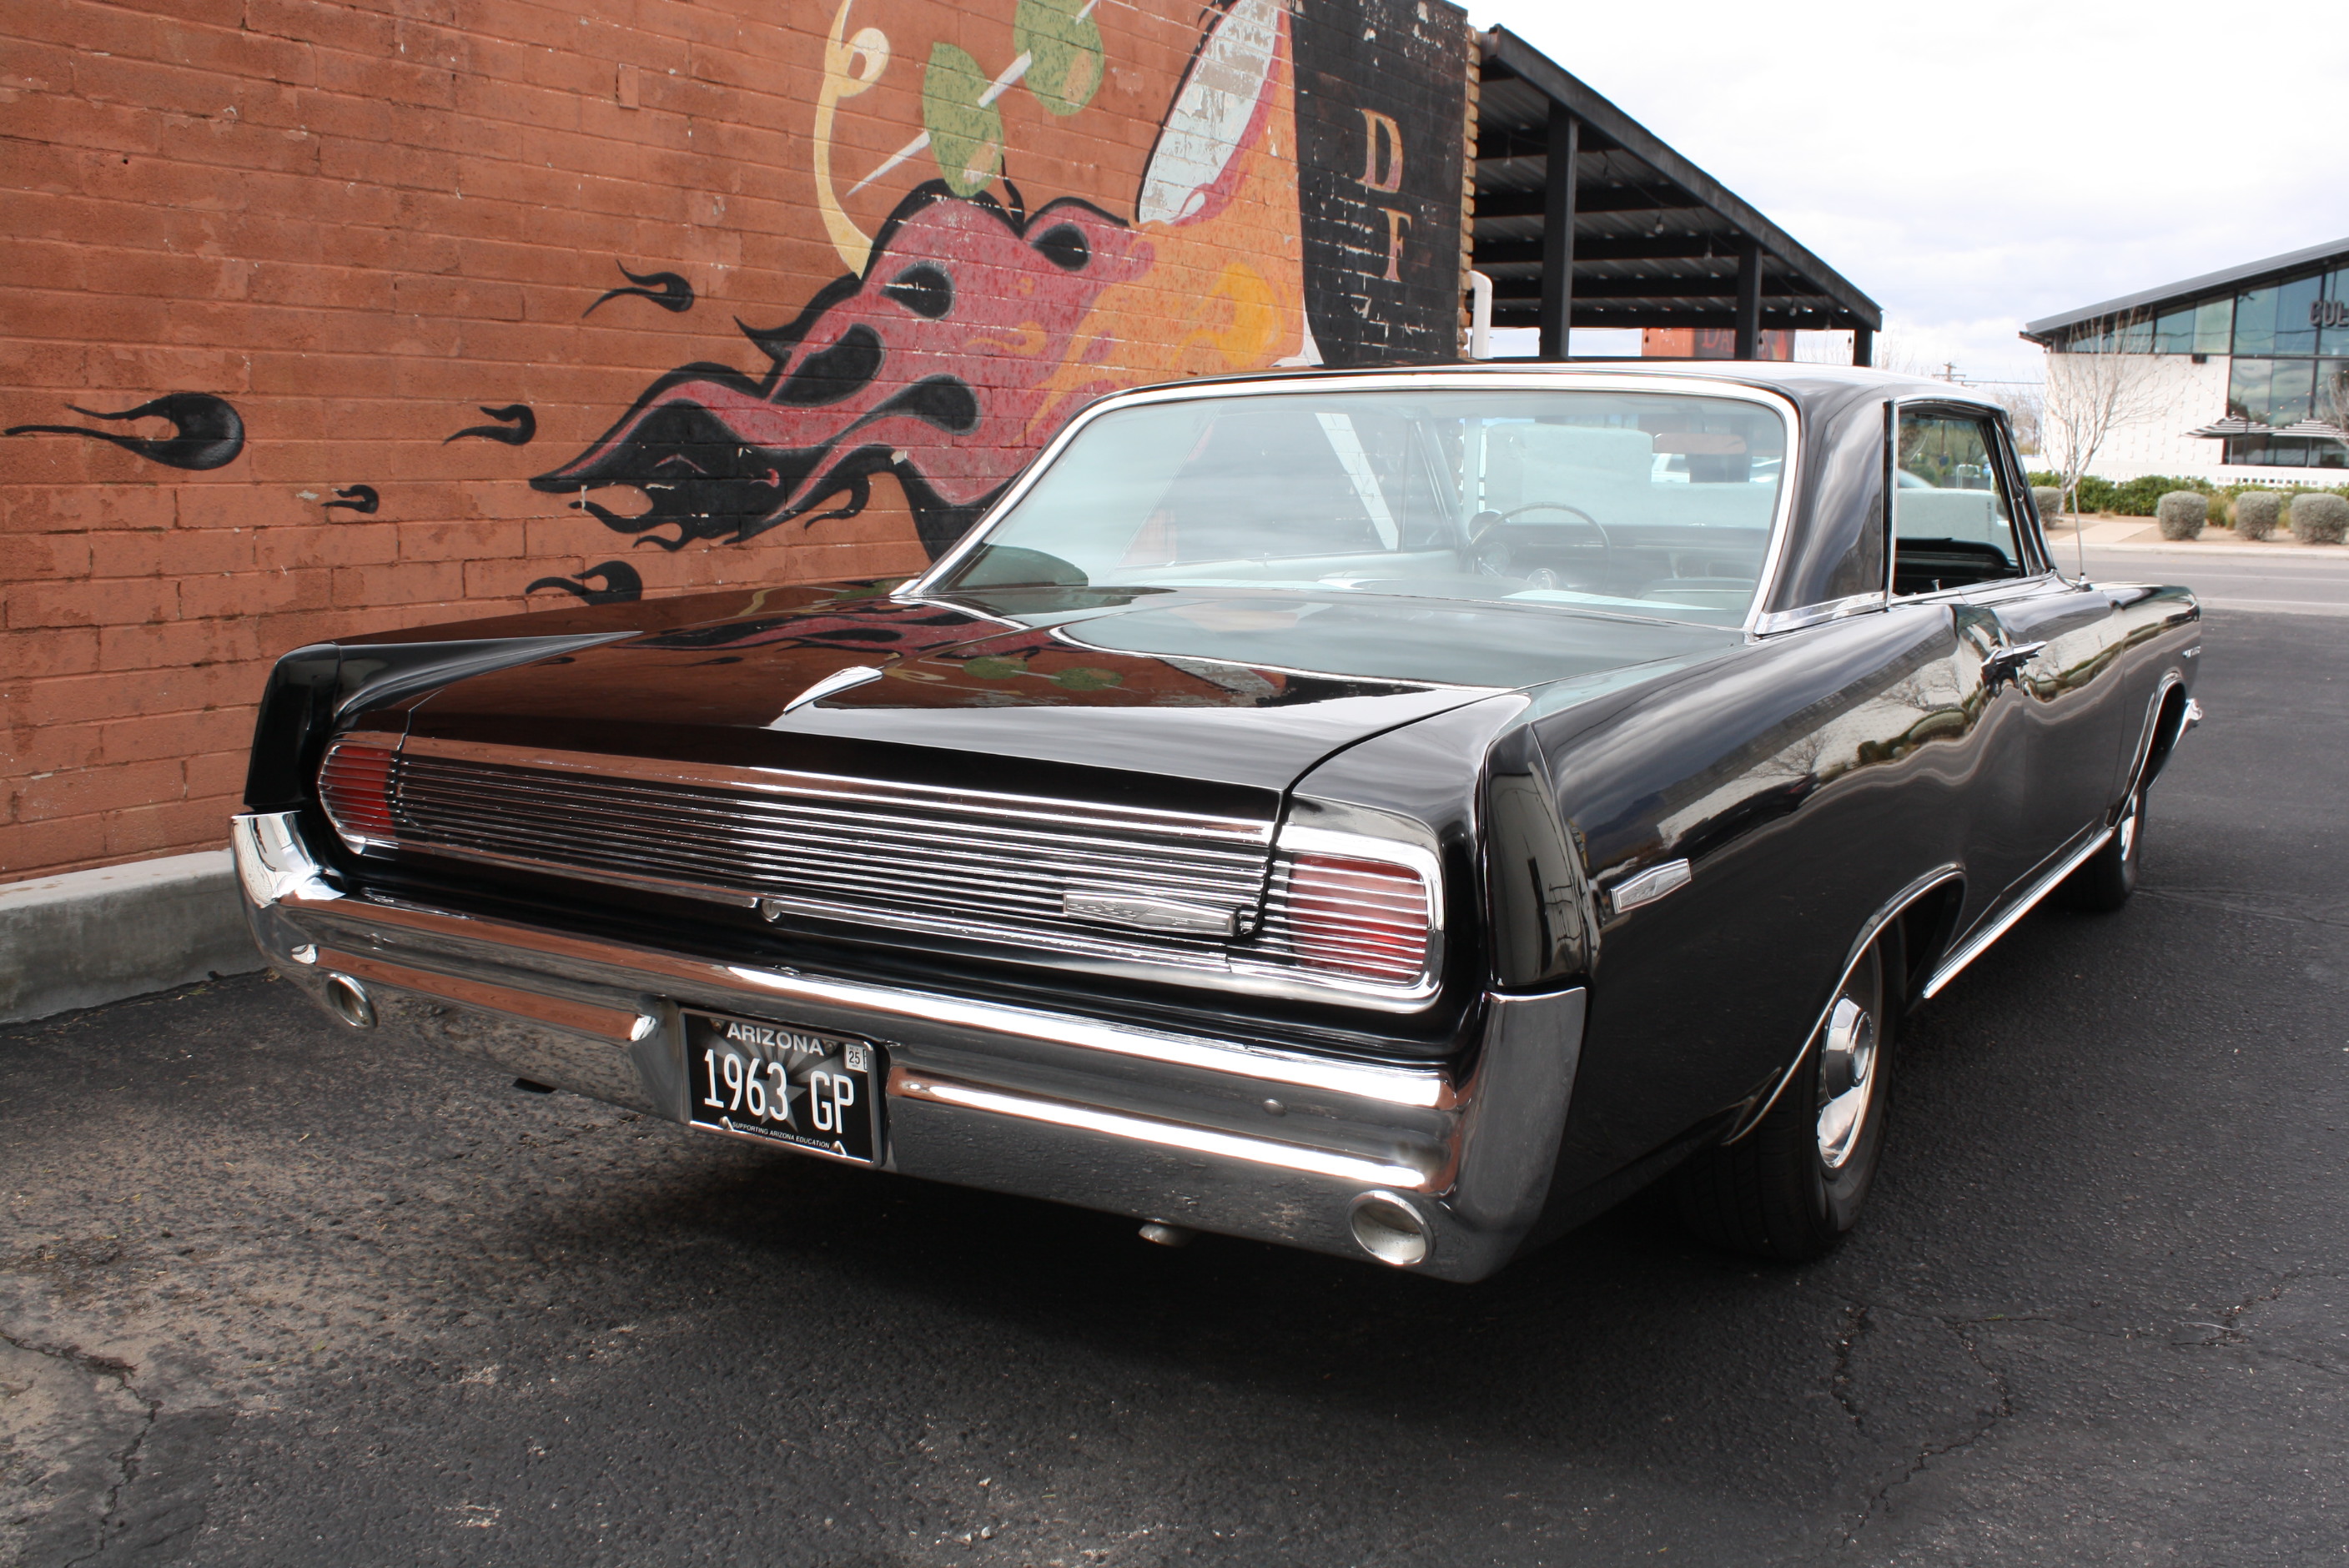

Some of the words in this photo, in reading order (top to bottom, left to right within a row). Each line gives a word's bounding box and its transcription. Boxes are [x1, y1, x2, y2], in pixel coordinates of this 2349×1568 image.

[1355, 108, 1403, 193] D
[1381, 207, 1411, 283] F
[727, 1023, 824, 1056] ARIZONA
[849, 1050, 860, 1064] 25
[704, 1048, 788, 1120] 1963
[810, 1070, 854, 1134] GP
[732, 1121, 768, 1135] SUPPORTING
[769, 1130, 795, 1141] ARIZONA
[796, 1135, 831, 1148] EDUCATION
